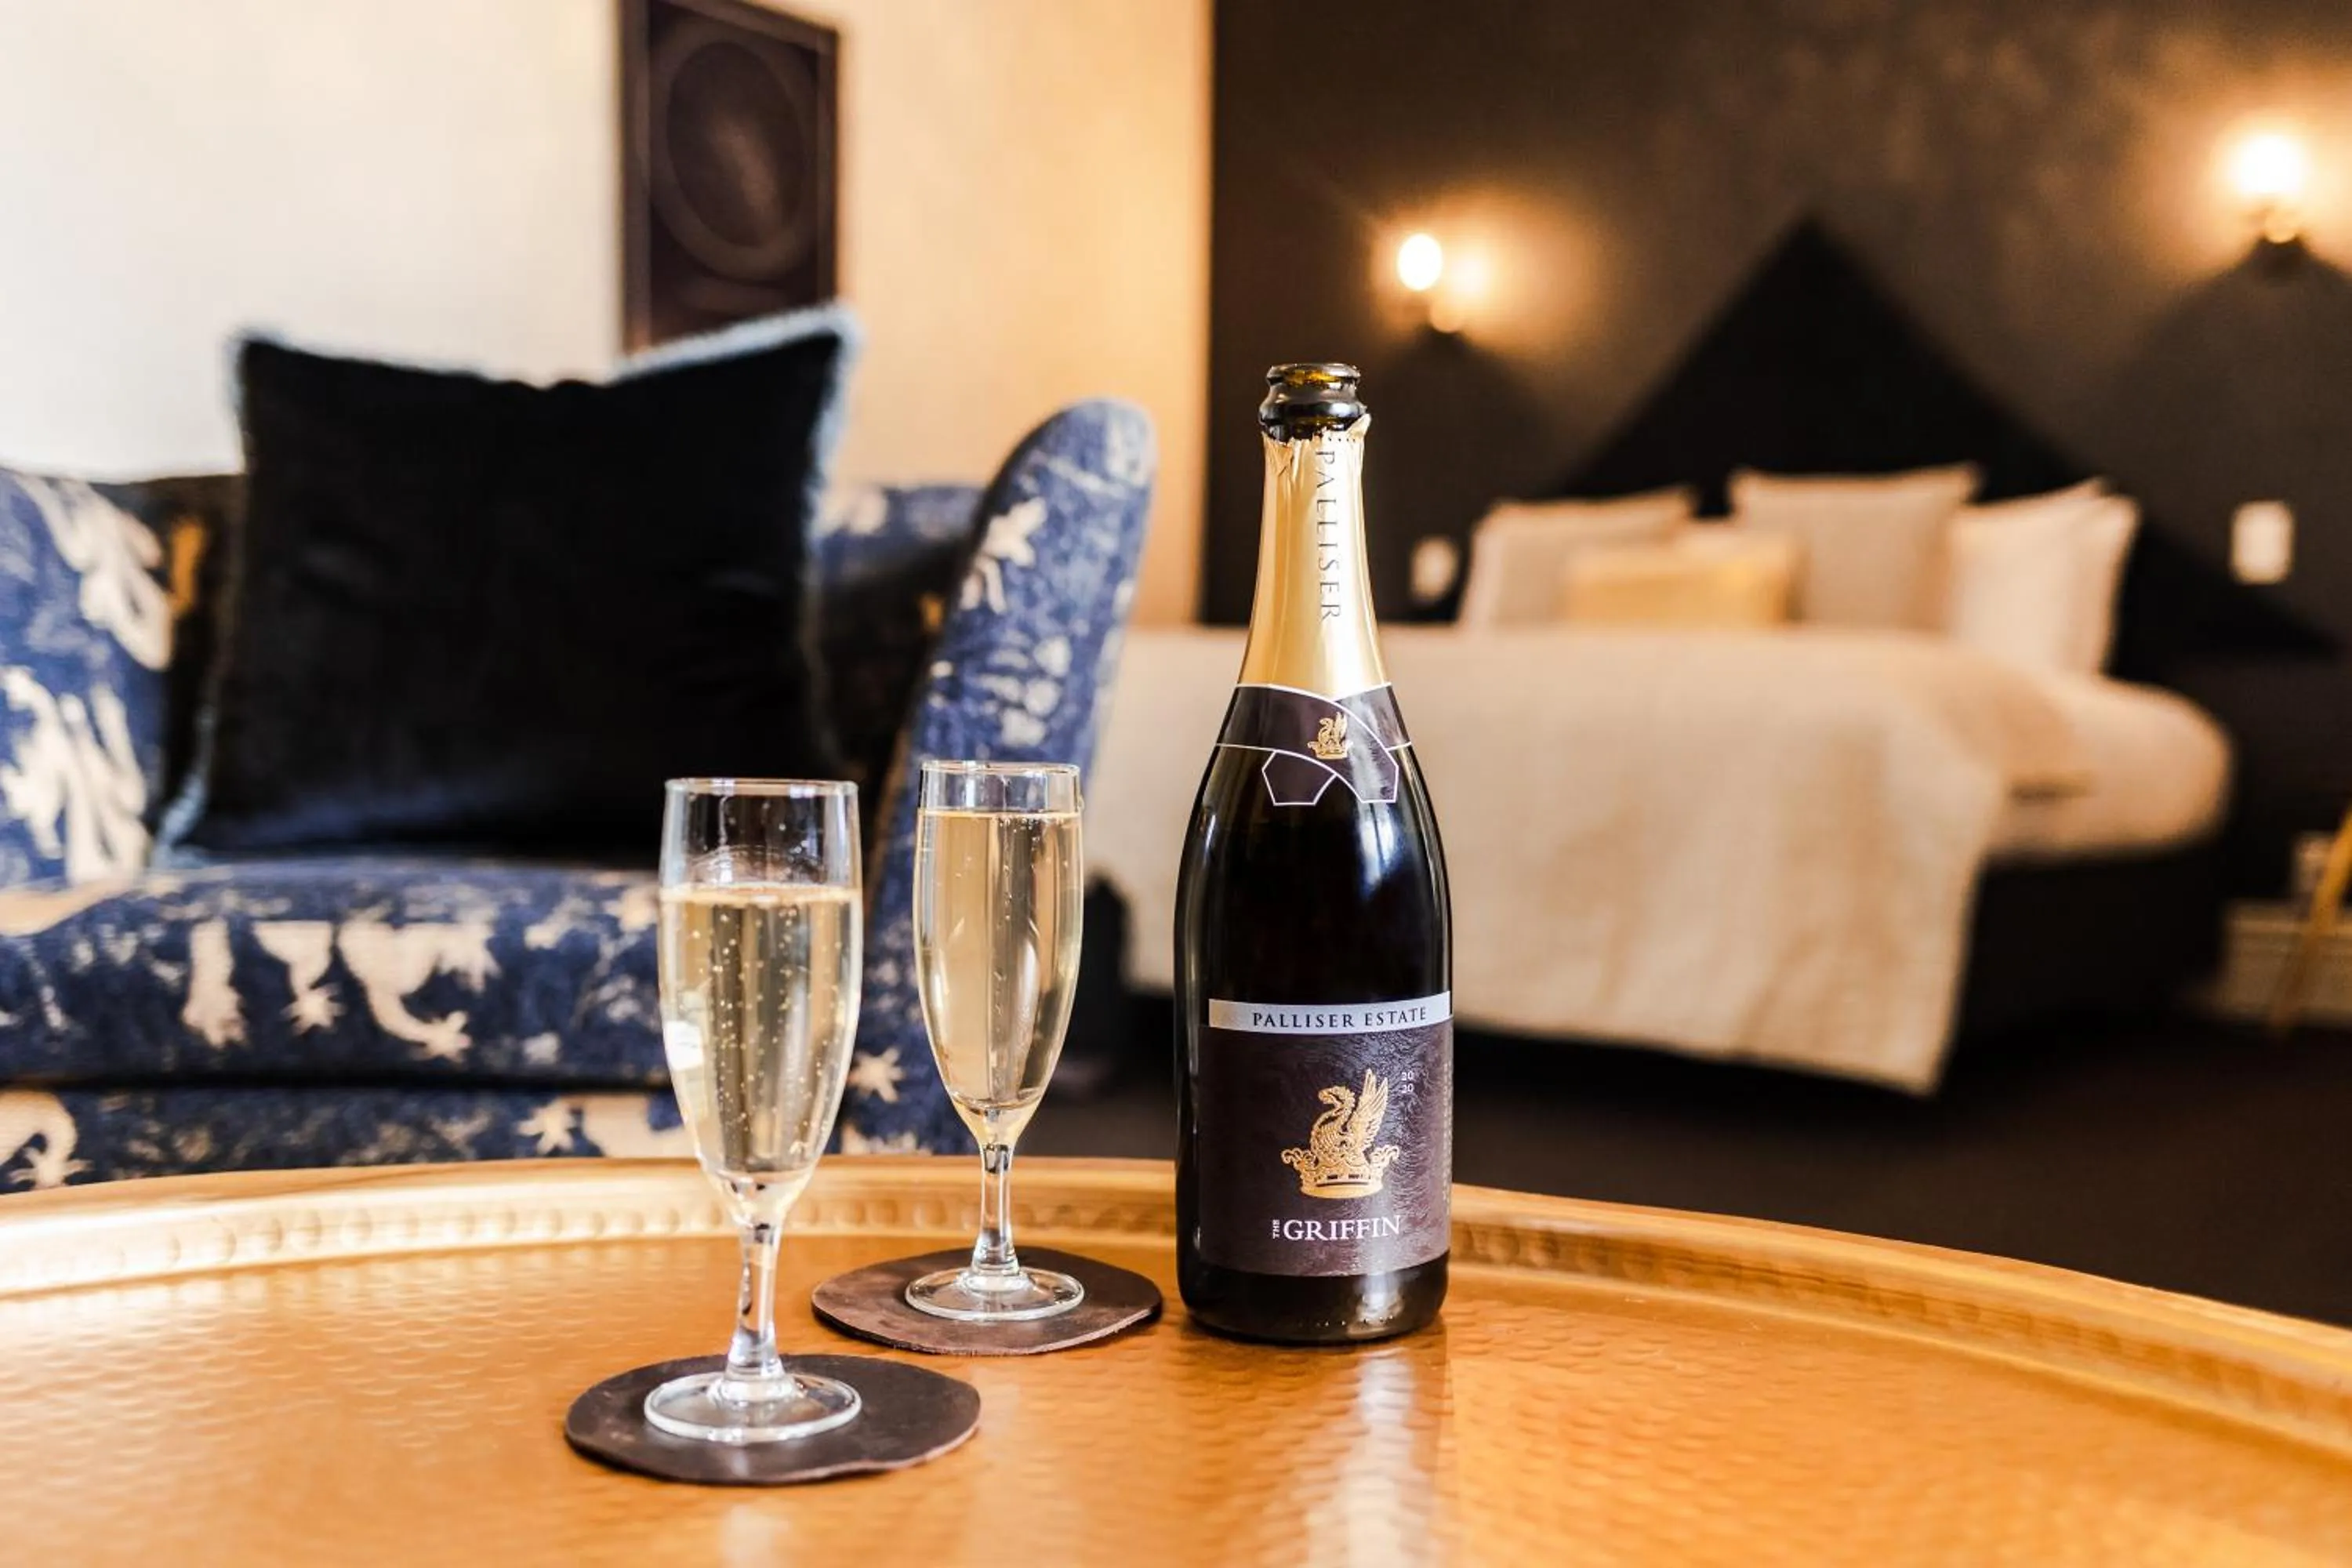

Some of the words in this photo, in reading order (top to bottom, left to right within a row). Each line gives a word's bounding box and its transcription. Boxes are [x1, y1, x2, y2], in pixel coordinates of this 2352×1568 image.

[1316, 450, 1341, 622] PALLISER
[1253, 1011, 1355, 1029] PALLISER
[1364, 1006, 1427, 1026] ESTATE
[1272, 1218, 1280, 1240] THE
[1283, 1214, 1401, 1241] GRIFFIN
